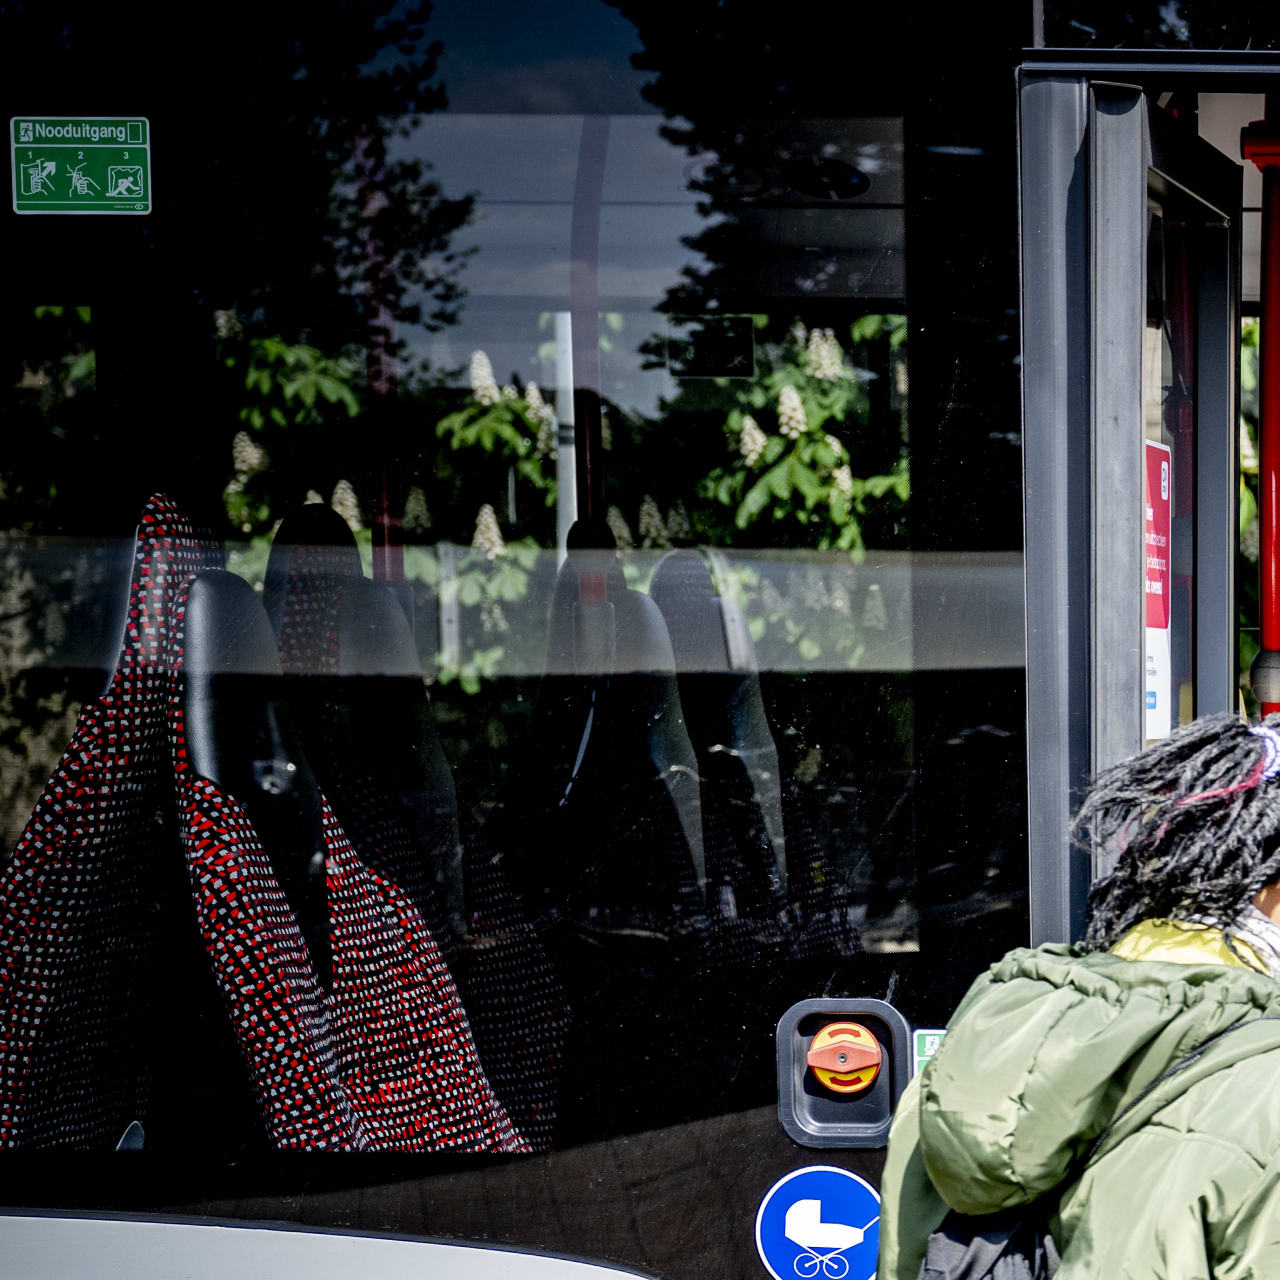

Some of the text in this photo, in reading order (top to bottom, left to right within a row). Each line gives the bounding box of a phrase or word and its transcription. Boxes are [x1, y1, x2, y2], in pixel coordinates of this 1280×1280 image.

[35, 123, 126, 142] Nooduitgang
[27, 151, 129, 160] 1 2 3
